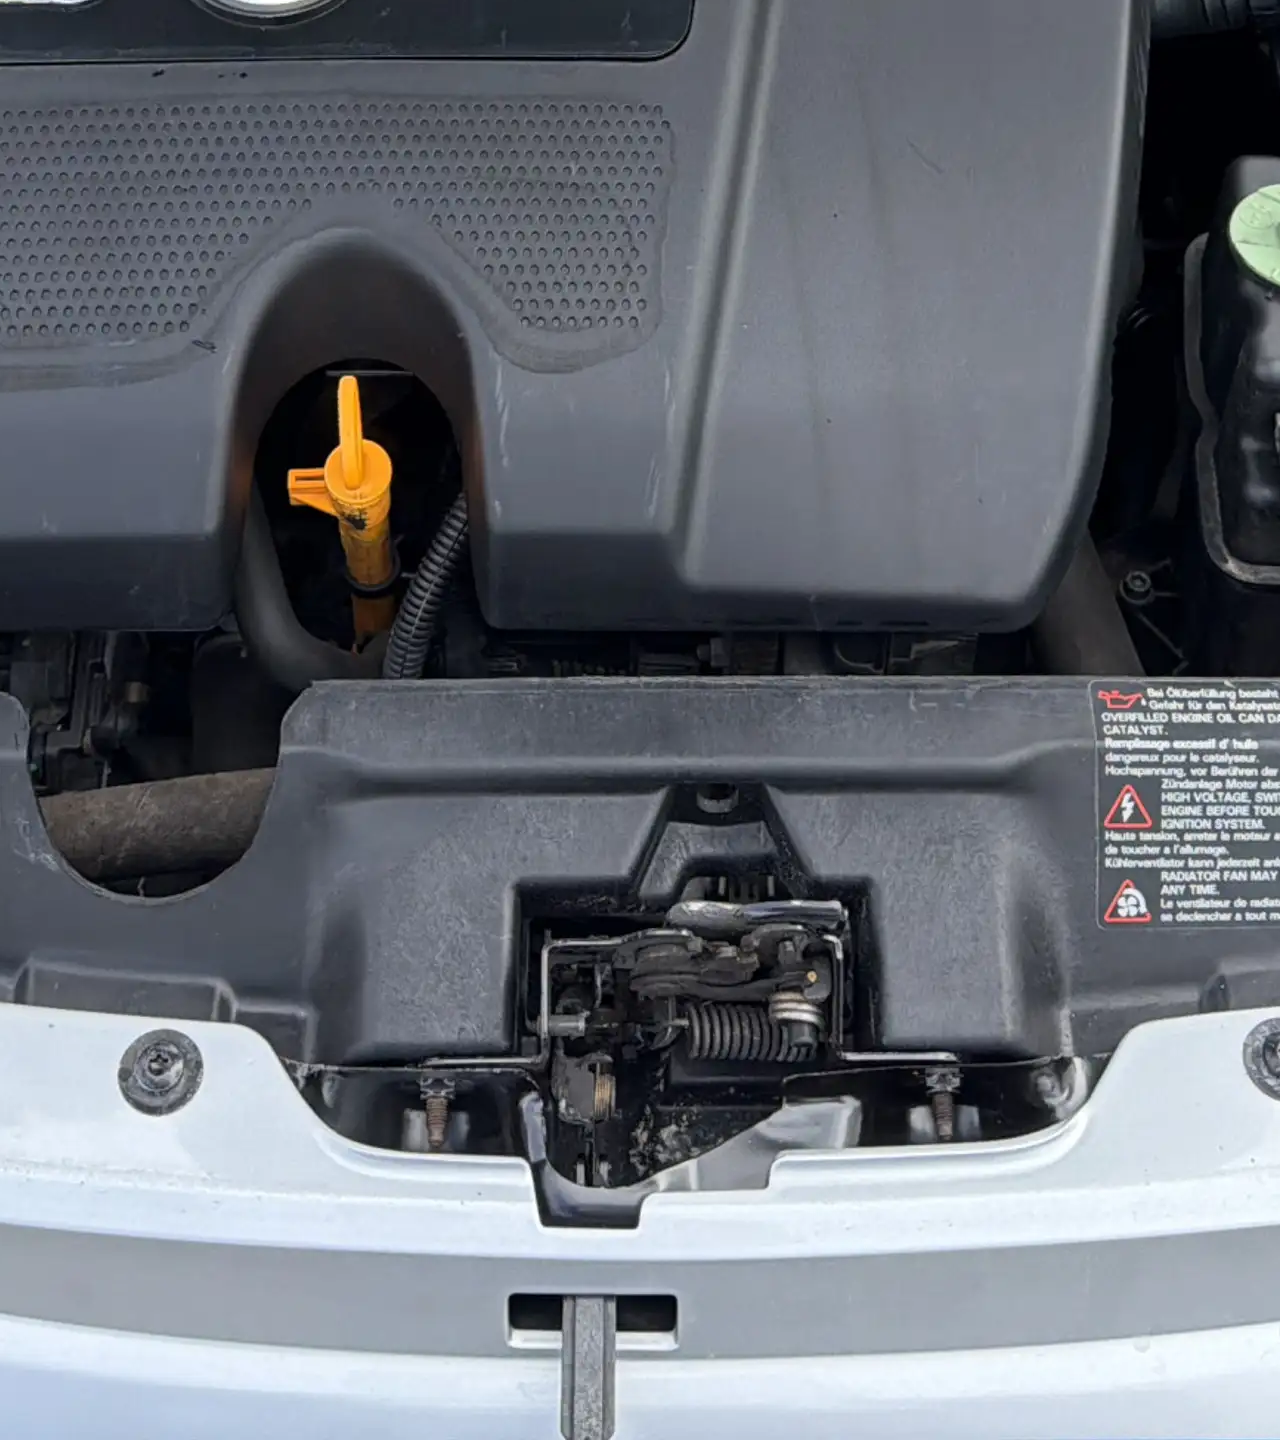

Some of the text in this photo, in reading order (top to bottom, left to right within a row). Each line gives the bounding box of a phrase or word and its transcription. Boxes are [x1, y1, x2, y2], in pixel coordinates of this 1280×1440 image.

[1146, 687, 1164, 698] Bei
[1149, 700, 1184, 710] Gefahr
[1206, 701, 1226, 711] den
[1101, 712, 1169, 723] OVERFILLED
[1171, 712, 1214, 723] ENGINE
[1216, 713, 1236, 724] OIL
[1238, 713, 1264, 724] CAN
[1103, 724, 1169, 736] CATALYST.
[1104, 751, 1160, 764] dangereux
[1162, 754, 1187, 764] pour
[1189, 752, 1200, 762] le
[1190, 768, 1208, 776] vor
[1260, 766, 1279, 777] der
[1161, 778, 1223, 791] Zündanlage
[1225, 778, 1258, 789] Motor
[1161, 792, 1191, 802] HIGH
[1161, 805, 1203, 816] ENGINE
[1206, 805, 1250, 816] BEFORE
[1161, 818, 1212, 830] IGNITION
[1105, 830, 1136, 841] Haute
[1220, 831, 1230, 841] le
[1233, 831, 1271, 841] moteur
[1104, 843, 1118, 855] de
[1121, 844, 1161, 855] toucher
[1188, 857, 1214, 868] kann
[1161, 870, 1220, 881] RADIATOR
[1223, 870, 1248, 881] FAN
[1250, 870, 1278, 881] MAY
[1160, 884, 1220, 895] ANY TIME.
[1160, 898, 1173, 909] Le
[1233, 897, 1247, 908] de
[1160, 913, 1173, 922] se
[1245, 911, 1267, 921] tout
